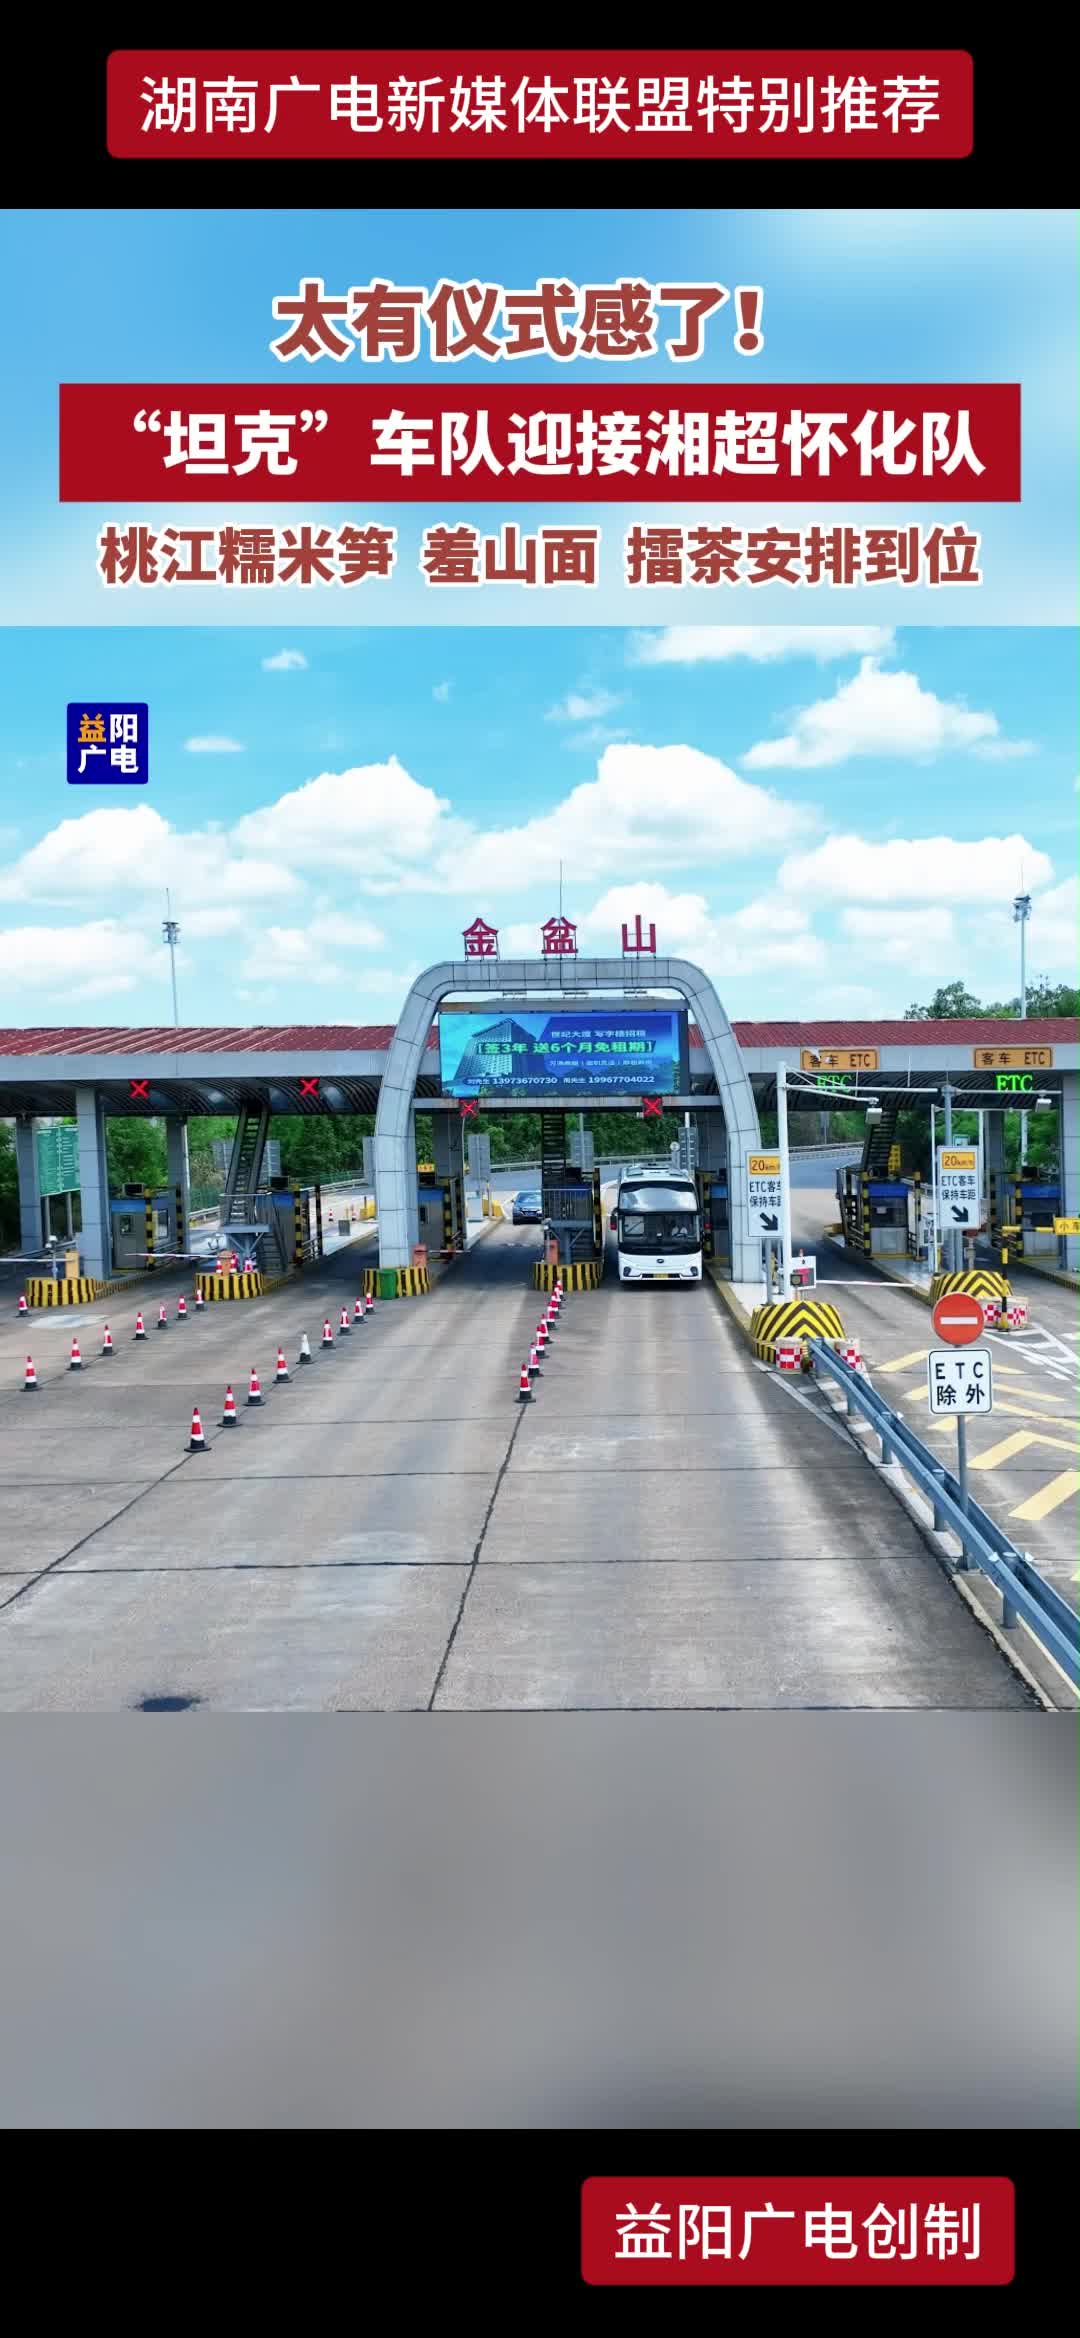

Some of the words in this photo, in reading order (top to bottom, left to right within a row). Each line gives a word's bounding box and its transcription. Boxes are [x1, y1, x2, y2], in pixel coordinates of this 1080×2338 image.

[462, 915, 657, 955] 金盆山
[850, 1054, 871, 1067] ETC
[981, 1052, 1011, 1064] 客车
[1024, 1052, 1045, 1065] ETC
[588, 1075, 655, 1084] 19967704022
[995, 1074, 1033, 1093] ETC
[941, 1175, 976, 1187] ETC客车
[942, 1189, 976, 1201] 保持车距
[935, 1361, 983, 1380] ETC
[936, 1383, 985, 1406] 除外
